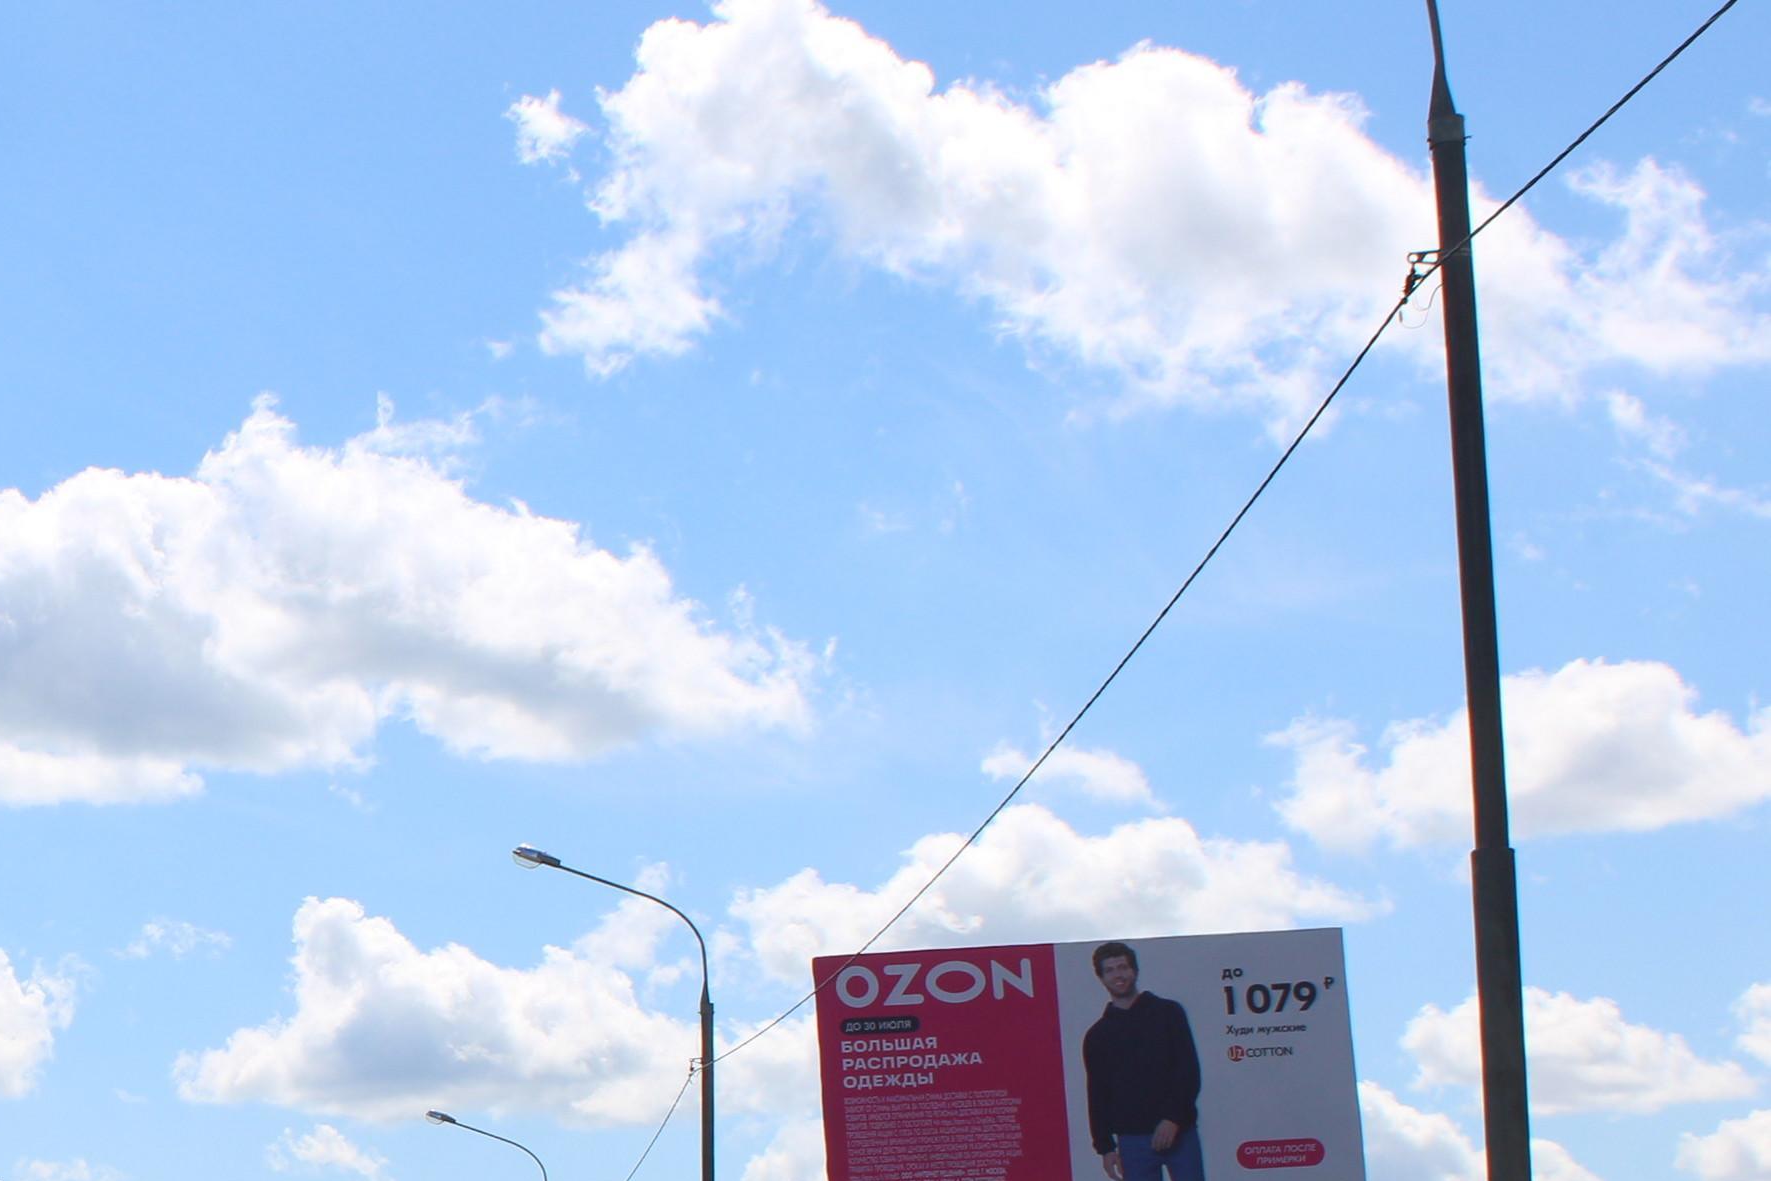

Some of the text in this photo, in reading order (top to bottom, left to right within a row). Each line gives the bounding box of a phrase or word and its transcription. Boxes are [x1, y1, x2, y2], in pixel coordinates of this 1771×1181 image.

[835, 958, 1034, 1009] OZON
[845, 1019, 912, 1033] ДО 30 ИЮЛЯ
[1225, 1025, 1254, 1036] Худи
[841, 1036, 938, 1053] БОЛЬШАЯ
[1245, 1046, 1293, 1058] COTTON
[842, 1052, 983, 1071] РАСПРОДАЖА
[843, 1072, 934, 1090] ОДЕЖДЫ
